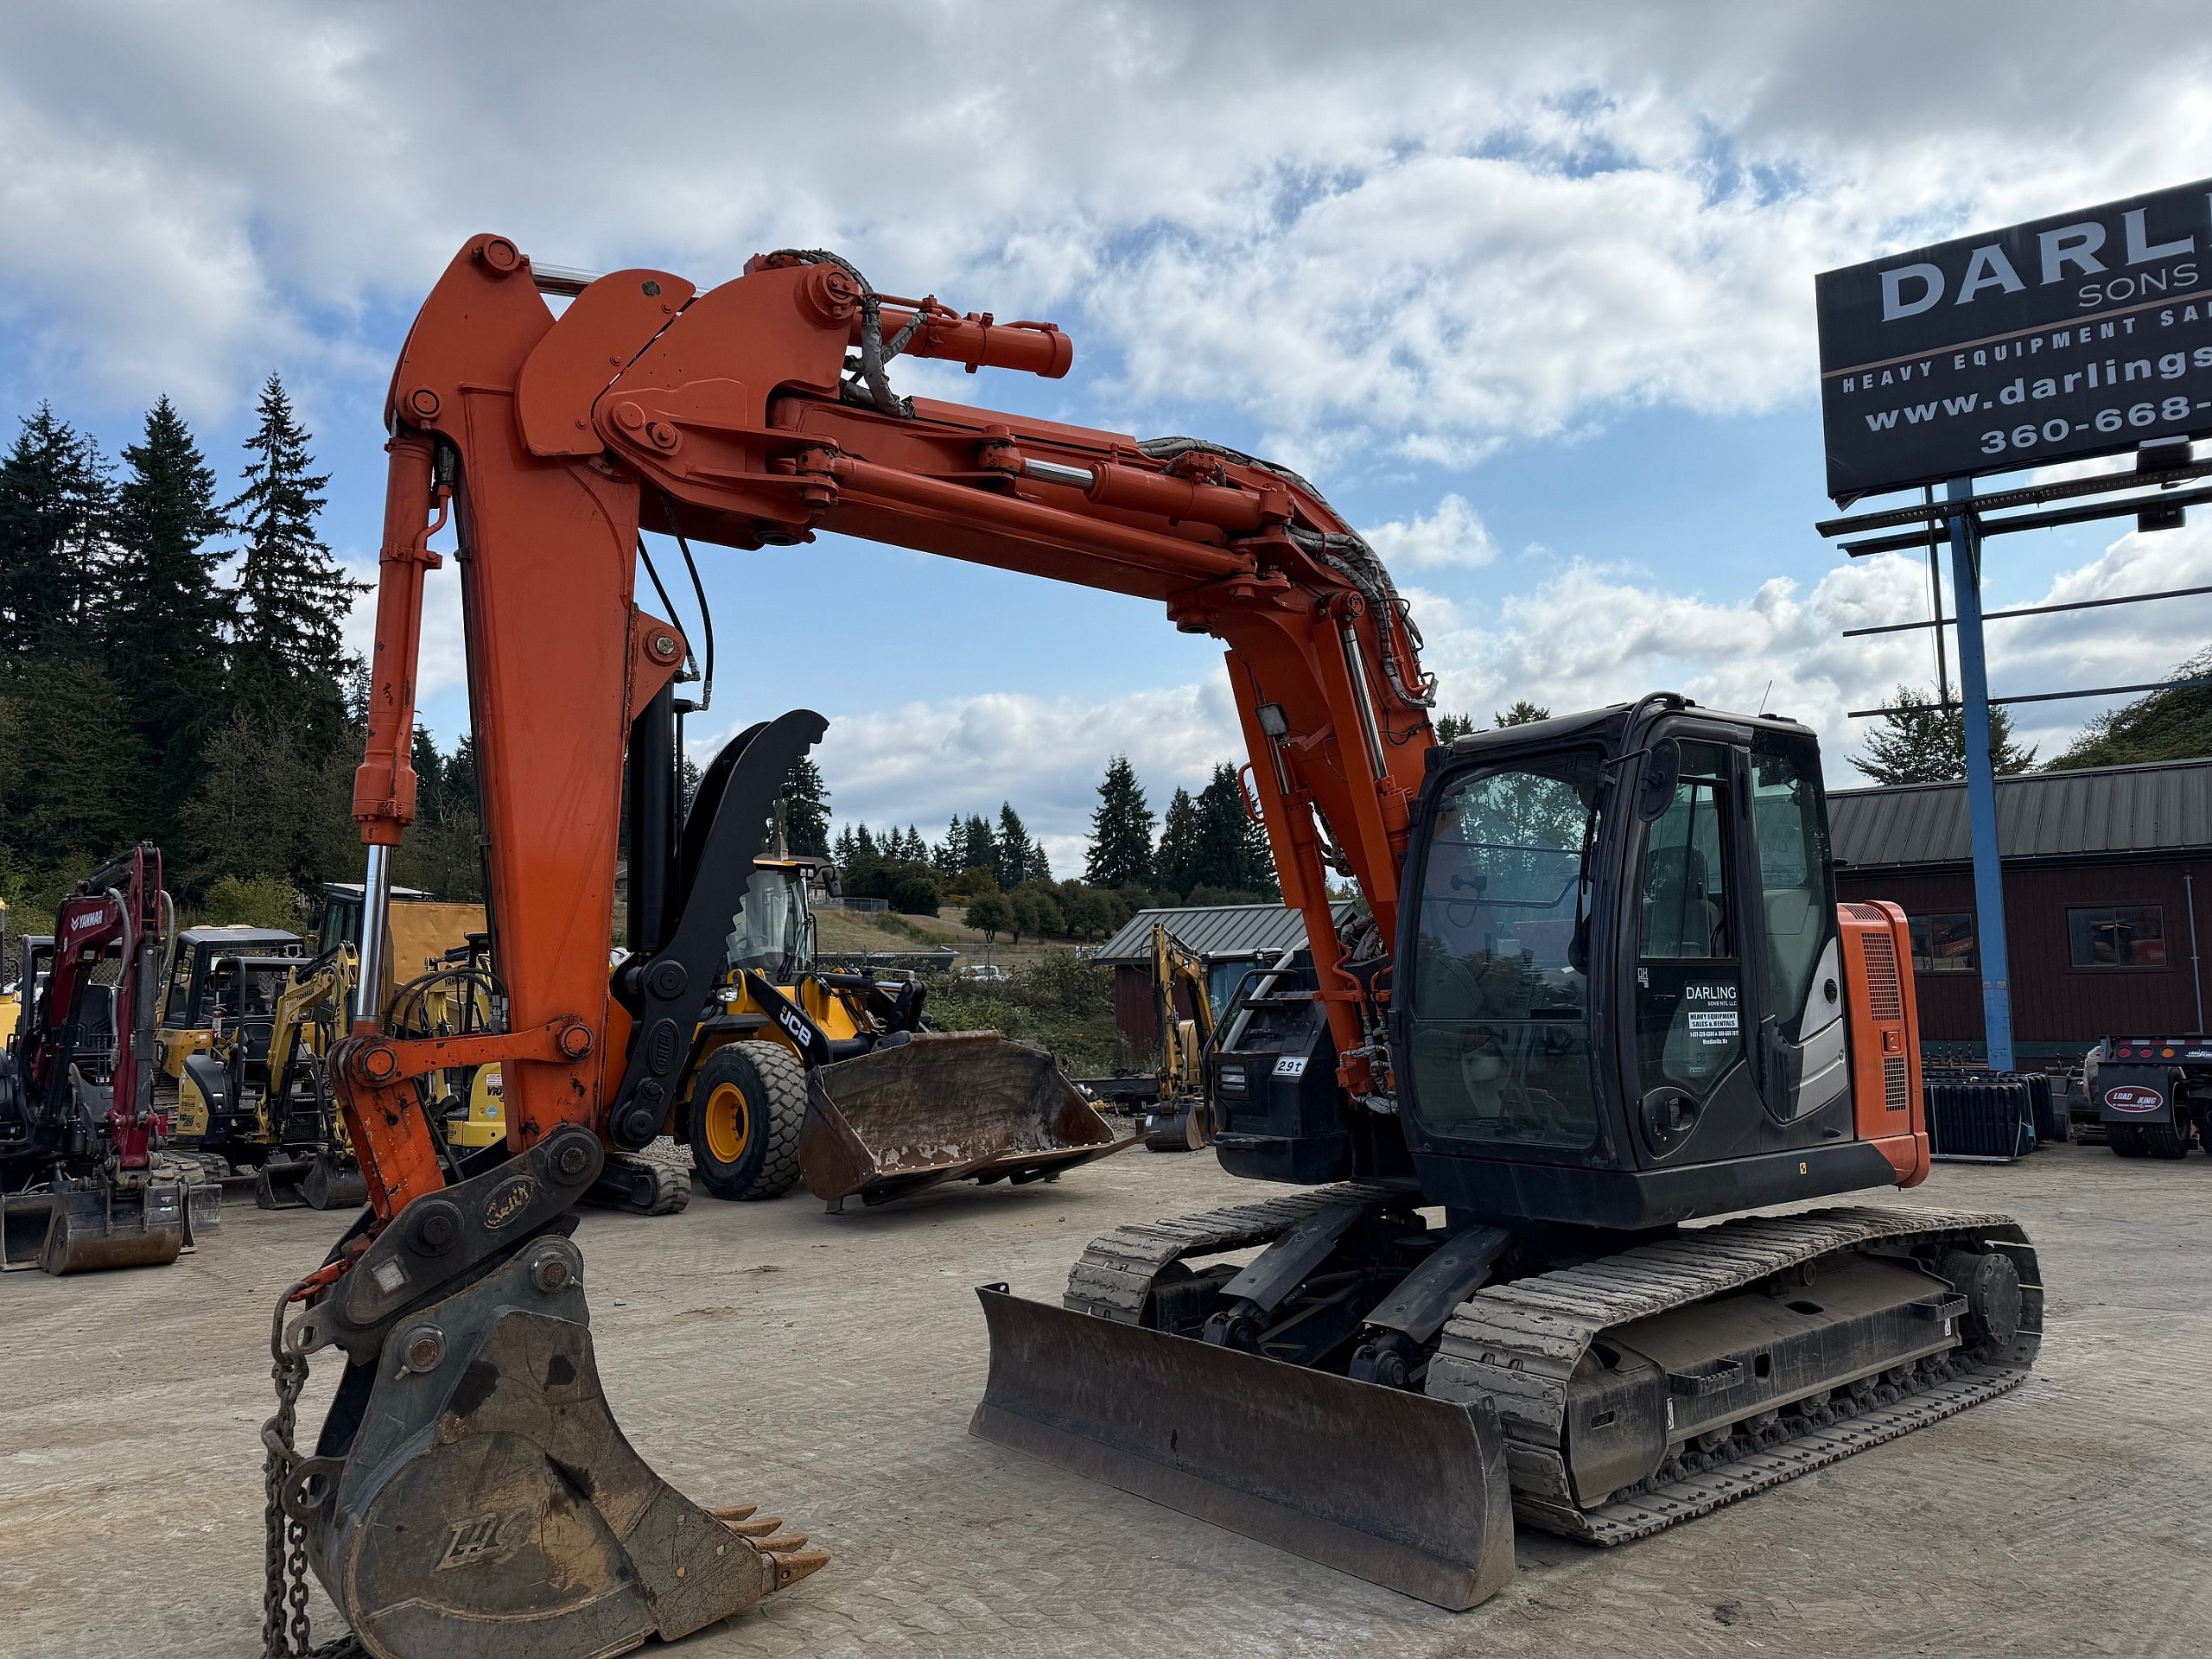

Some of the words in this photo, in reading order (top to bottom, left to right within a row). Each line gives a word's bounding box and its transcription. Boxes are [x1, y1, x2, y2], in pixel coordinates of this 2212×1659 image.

[2078, 264, 2198, 308] SONS
[1843, 361, 1932, 393] HEAVY
[1955, 318, 2135, 370] EQUIPMENT
[1866, 346, 2212, 432] www.darlings
[1980, 396, 2212, 454] 360-668-
[79, 910, 103, 929] YANMAR
[296, 988, 315, 1001] YANMAR
[1686, 987, 1737, 1000] DARLING
[779, 1007, 811, 1047] JCB
[1277, 1061, 1294, 1071] 2.9
[1295, 1061, 1302, 1071] t
